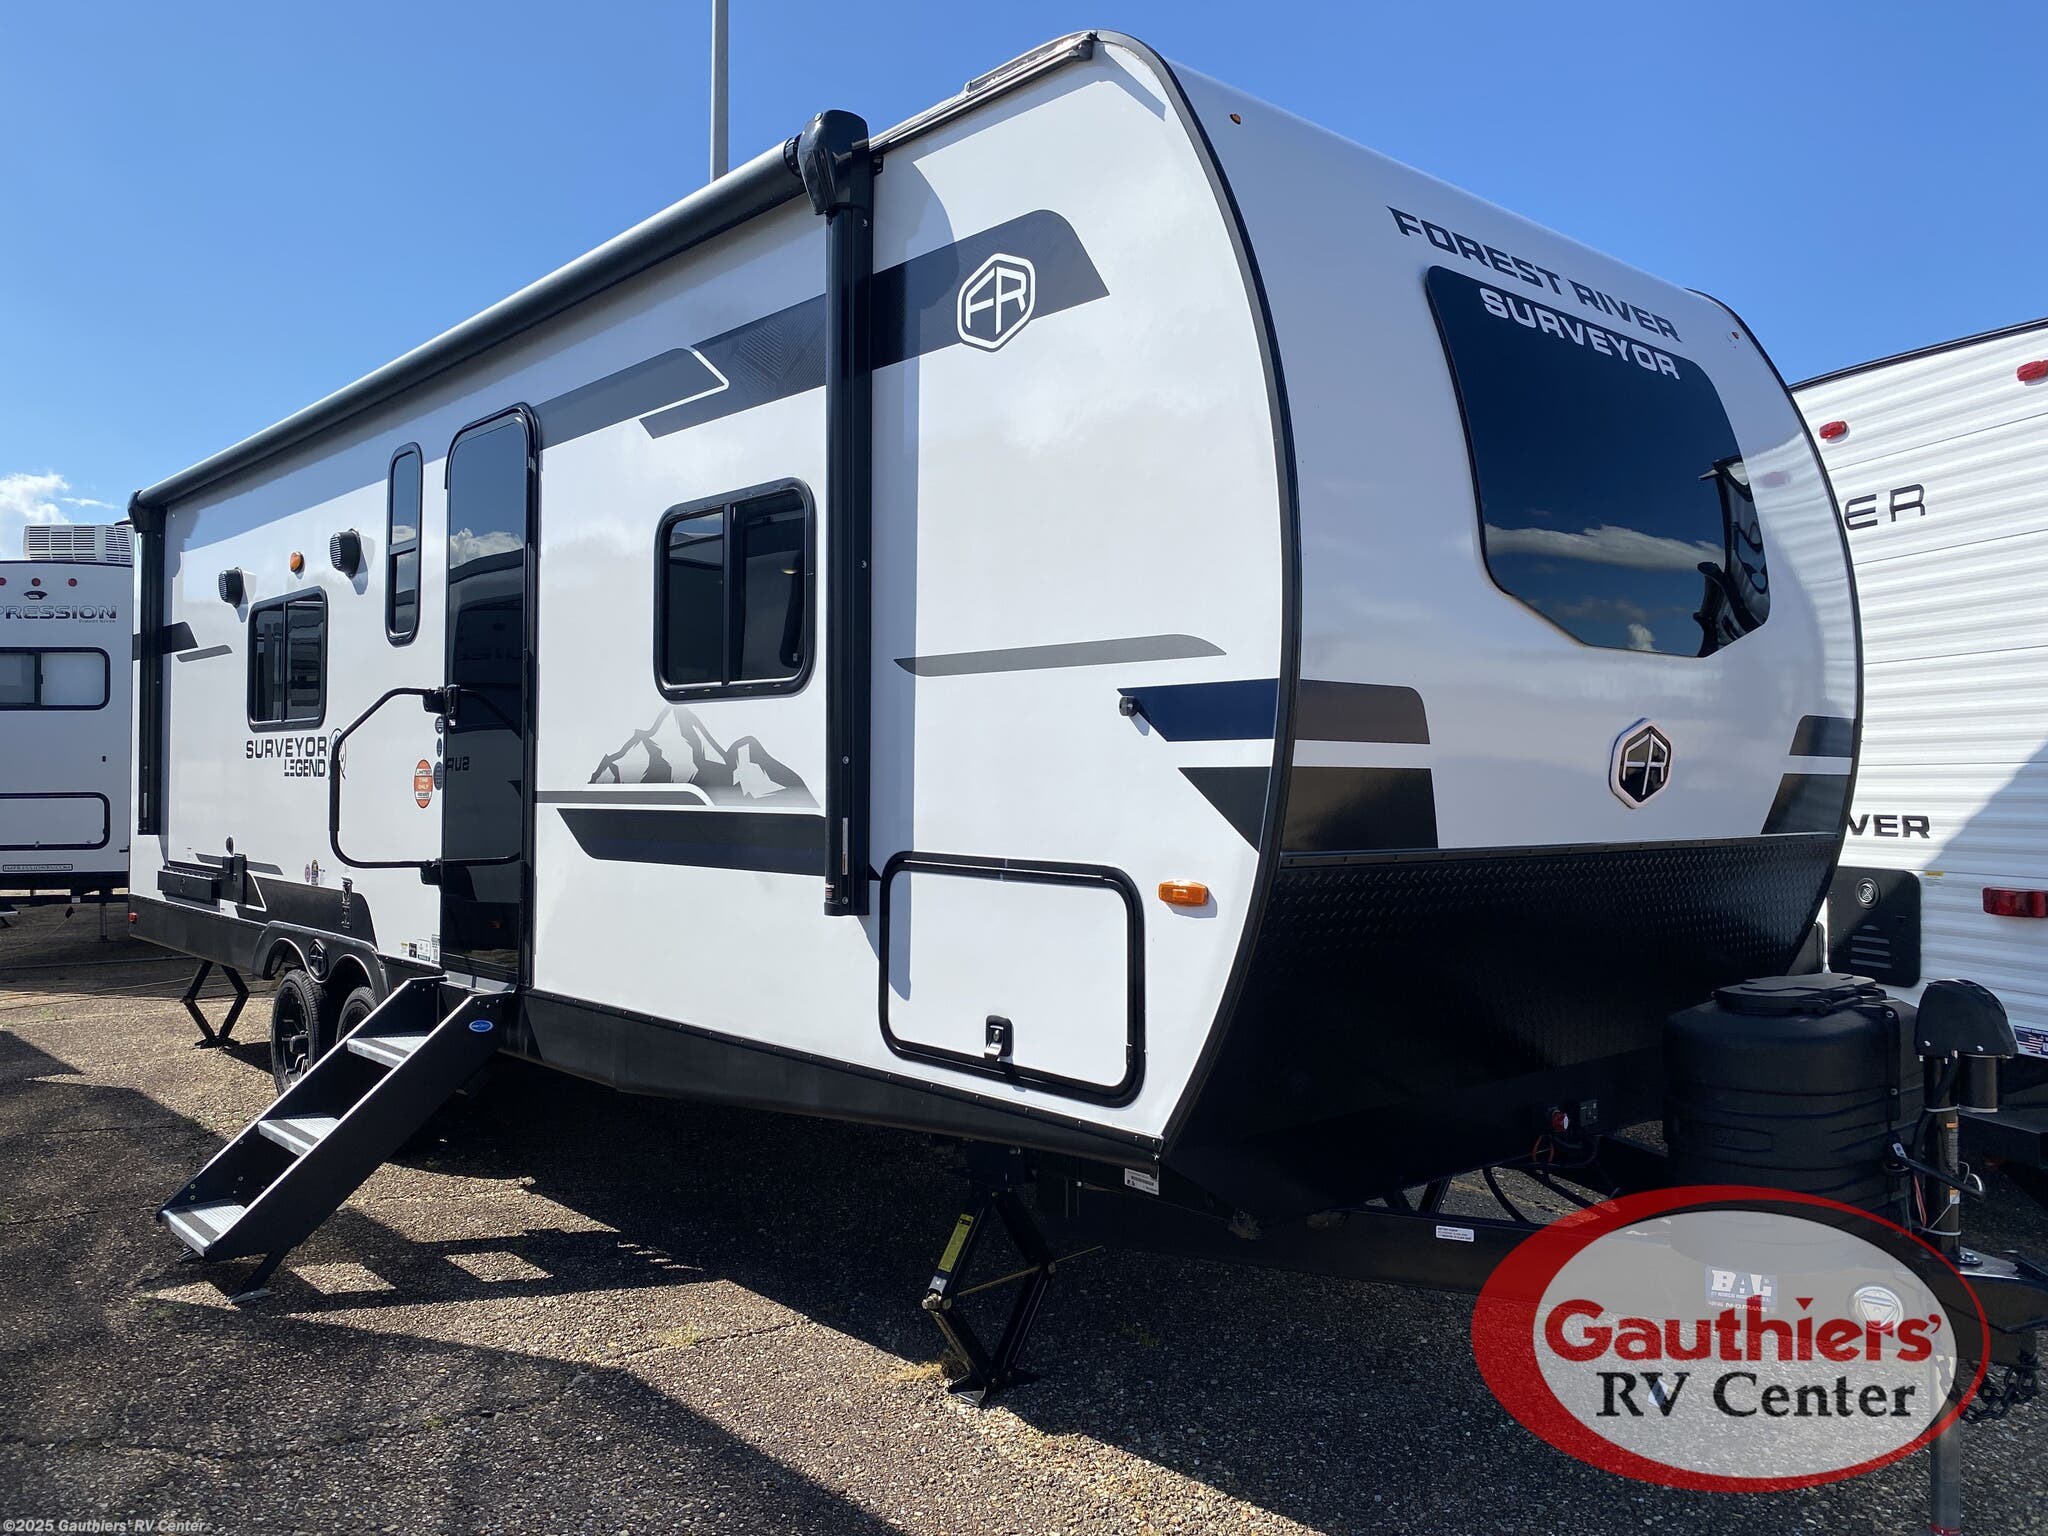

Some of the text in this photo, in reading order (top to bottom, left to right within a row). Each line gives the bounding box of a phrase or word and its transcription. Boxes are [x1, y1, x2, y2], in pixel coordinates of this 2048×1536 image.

[1386, 205, 1683, 343] FOREST RIVER
[1479, 287, 1681, 380] SURVEYOR
[0, 605, 117, 620] RESSION
[246, 736, 327, 759] SURVEYOR
[283, 759, 326, 777] LEGEND
